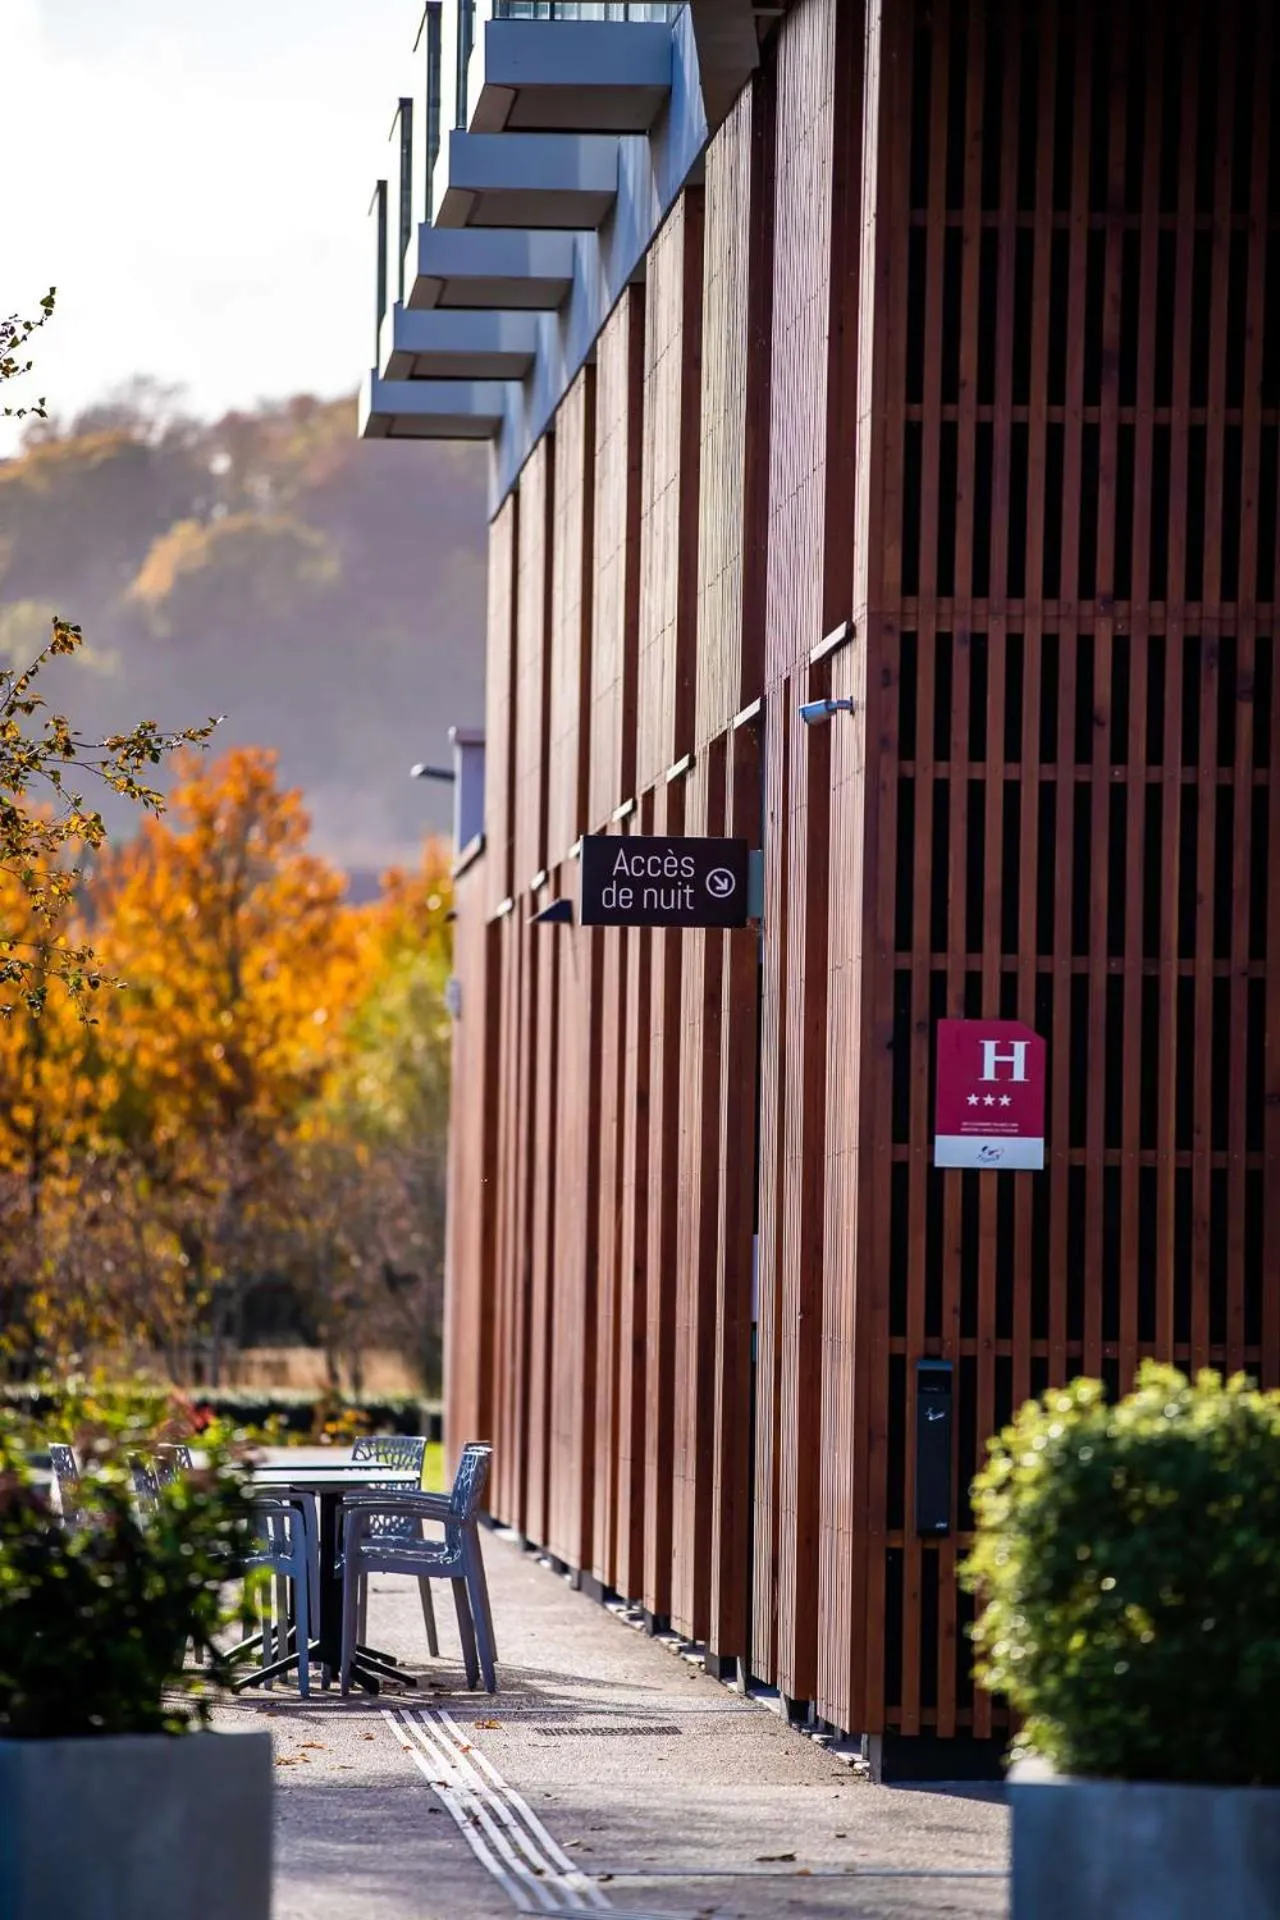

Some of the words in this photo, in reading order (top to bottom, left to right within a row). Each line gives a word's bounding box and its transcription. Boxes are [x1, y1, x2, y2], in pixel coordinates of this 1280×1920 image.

[612, 848, 695, 878] Accès
[602, 880, 633, 909] de
[643, 881, 694, 910] nuit
[978, 1040, 1031, 1082] H
